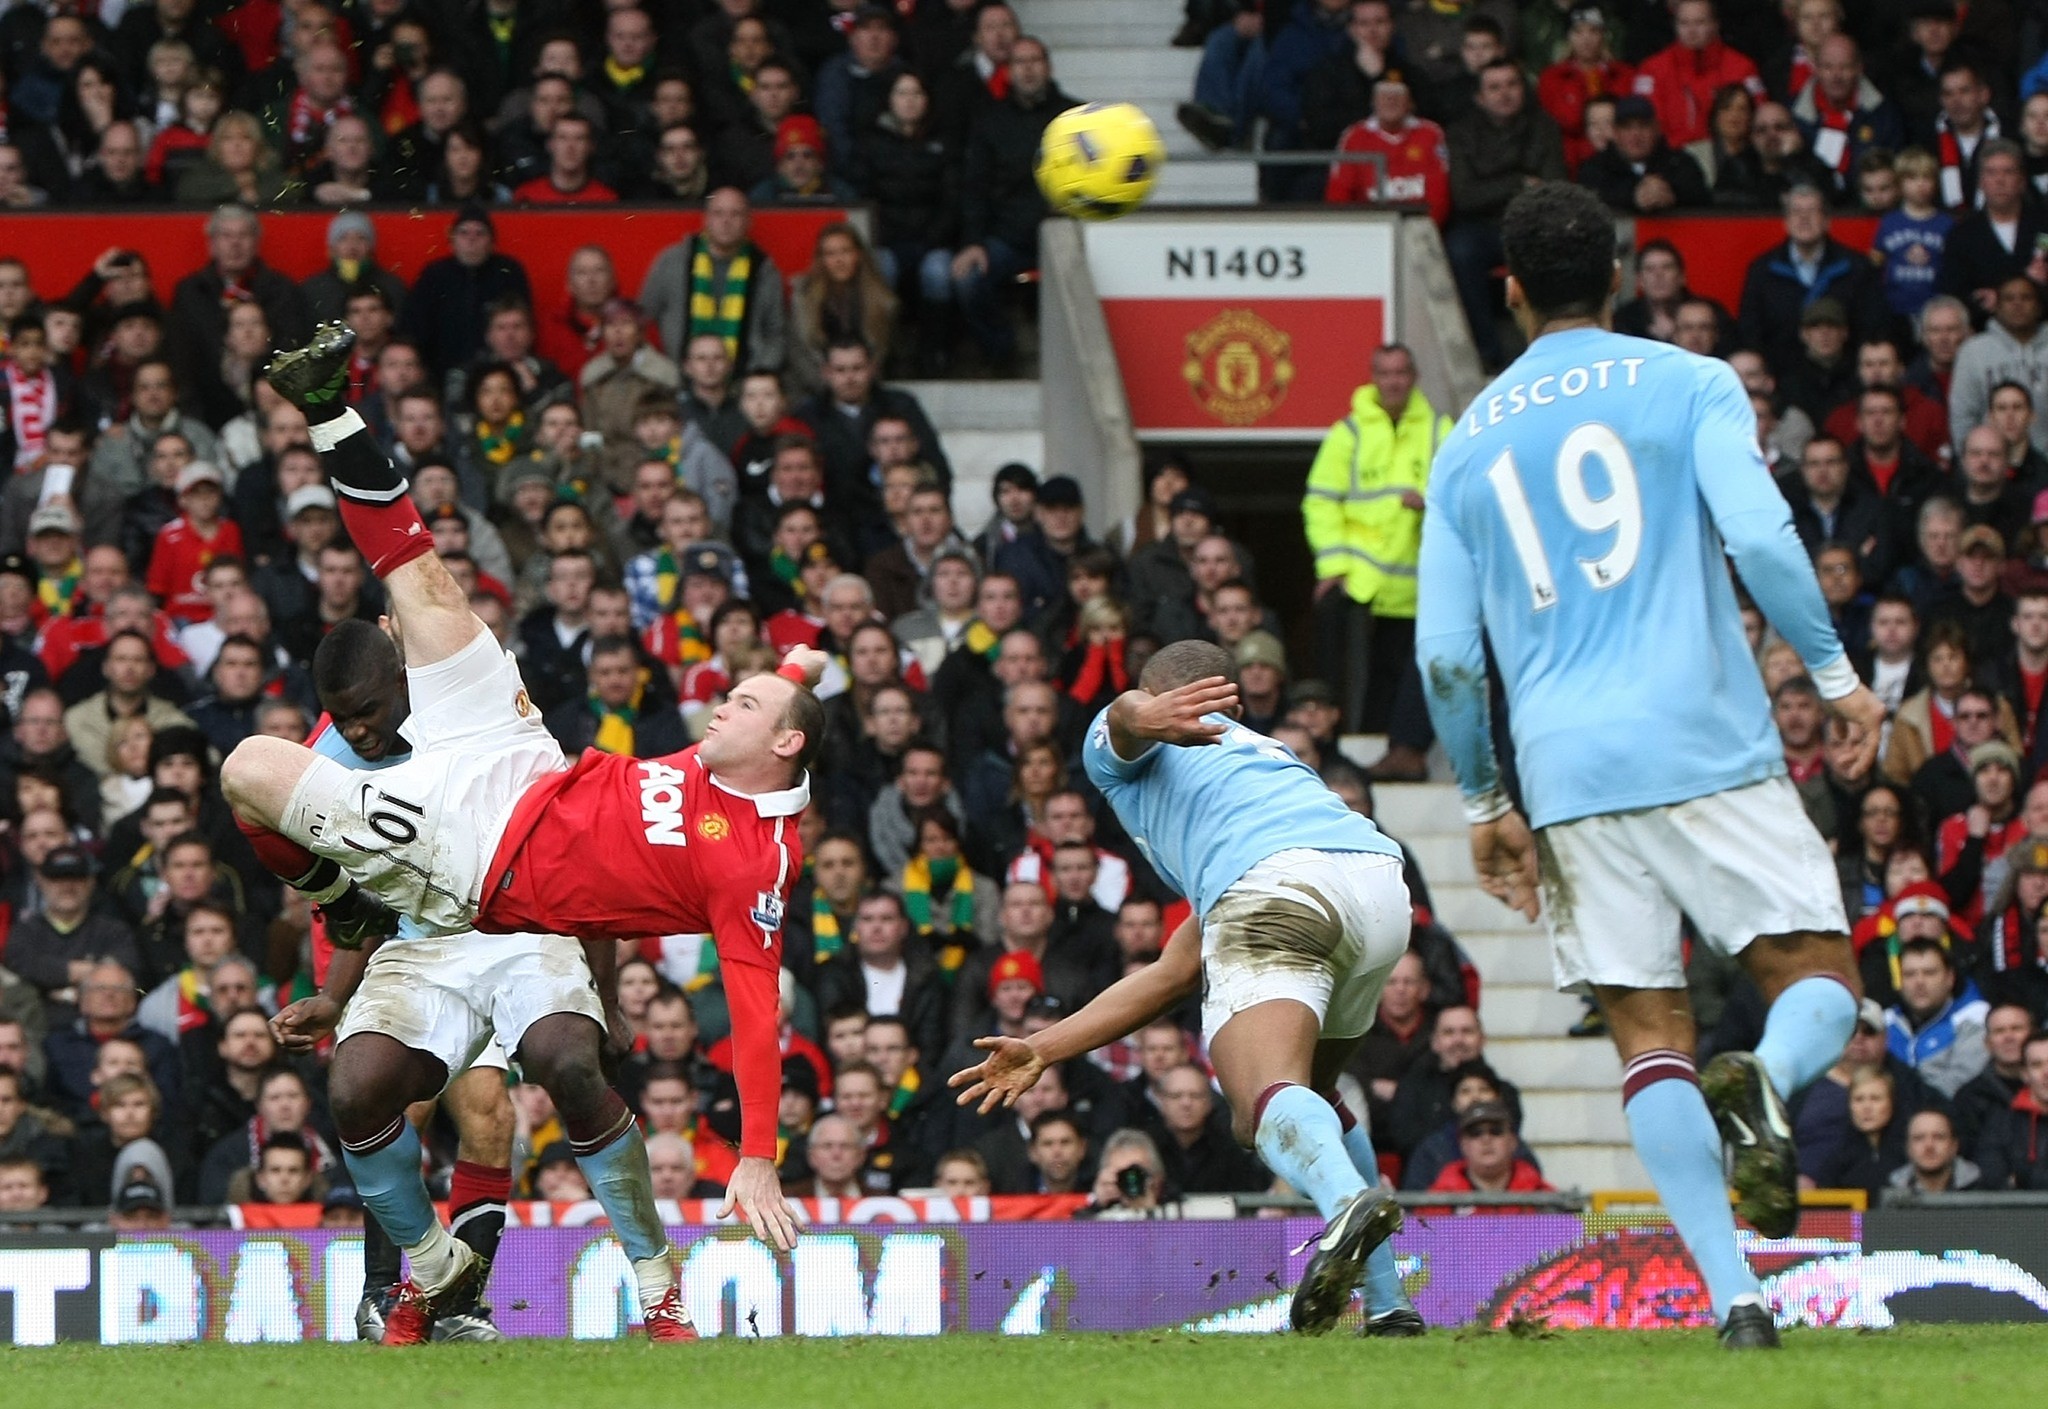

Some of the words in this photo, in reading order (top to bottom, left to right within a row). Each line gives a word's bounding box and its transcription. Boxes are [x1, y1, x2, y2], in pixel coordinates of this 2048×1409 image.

[1167, 247, 1305, 278] N1403
[1468, 357, 1645, 438] LESCOTT
[1485, 420, 1644, 615] 19
[367, 787, 427, 845] 10
[637, 760, 688, 848] AON
